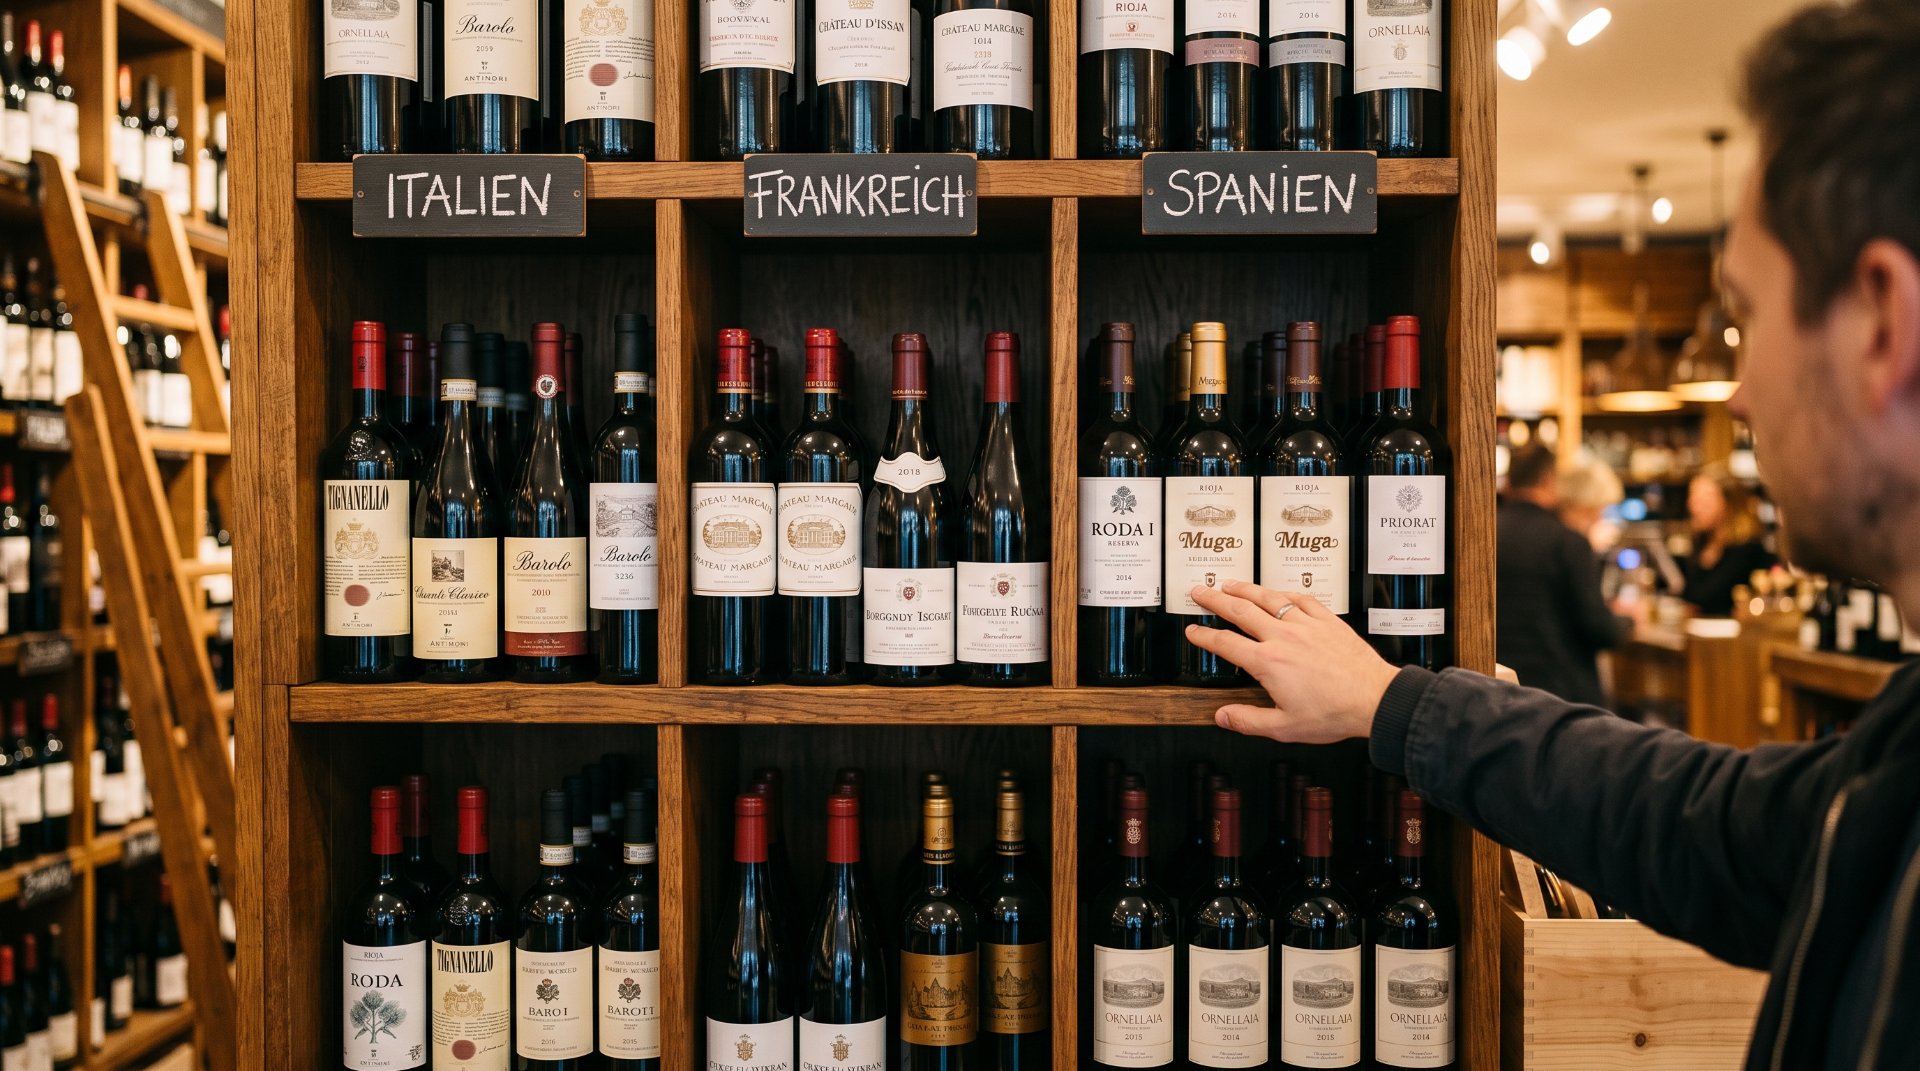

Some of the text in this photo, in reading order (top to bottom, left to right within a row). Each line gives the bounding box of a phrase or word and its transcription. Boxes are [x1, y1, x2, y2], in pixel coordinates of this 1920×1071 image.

[1115, 3, 1148, 12] RIOJA
[455, 14, 516, 35] Barolo
[818, 18, 905, 33] CHÂTEAU D'ISSAN
[1368, 24, 1431, 38] ORNELLAIA
[338, 28, 390, 39] ORNELLAIA
[388, 172, 552, 219] ITALIEN
[898, 468, 921, 476] 2018
[1199, 485, 1223, 493] RIOJA
[1295, 484, 1320, 493] RIOJA
[1380, 517, 1437, 528] PRIORAT
[1091, 522, 1154, 537] RODA I
[1178, 531, 1243, 553] Muga
[1274, 531, 1339, 553] Muga
[600, 545, 653, 562] Barolo
[512, 550, 572, 571] Barolo
[532, 588, 551, 597] 2010
[363, 951, 384, 960] RIOJA
[350, 972, 404, 988] RODA
[1105, 1012, 1163, 1025] ORNELLAIA
[1201, 1012, 1259, 1025] ORNELLAIA
[1295, 1012, 1353, 1025] ORNELLAIA
[1390, 1012, 1448, 1025] ORNELLAIA
[1124, 1033, 1143, 1041] 2015
[1222, 1033, 1240, 1041] 2014
[1316, 1033, 1335, 1041] 2015
[1412, 1033, 1430, 1041] 2014
